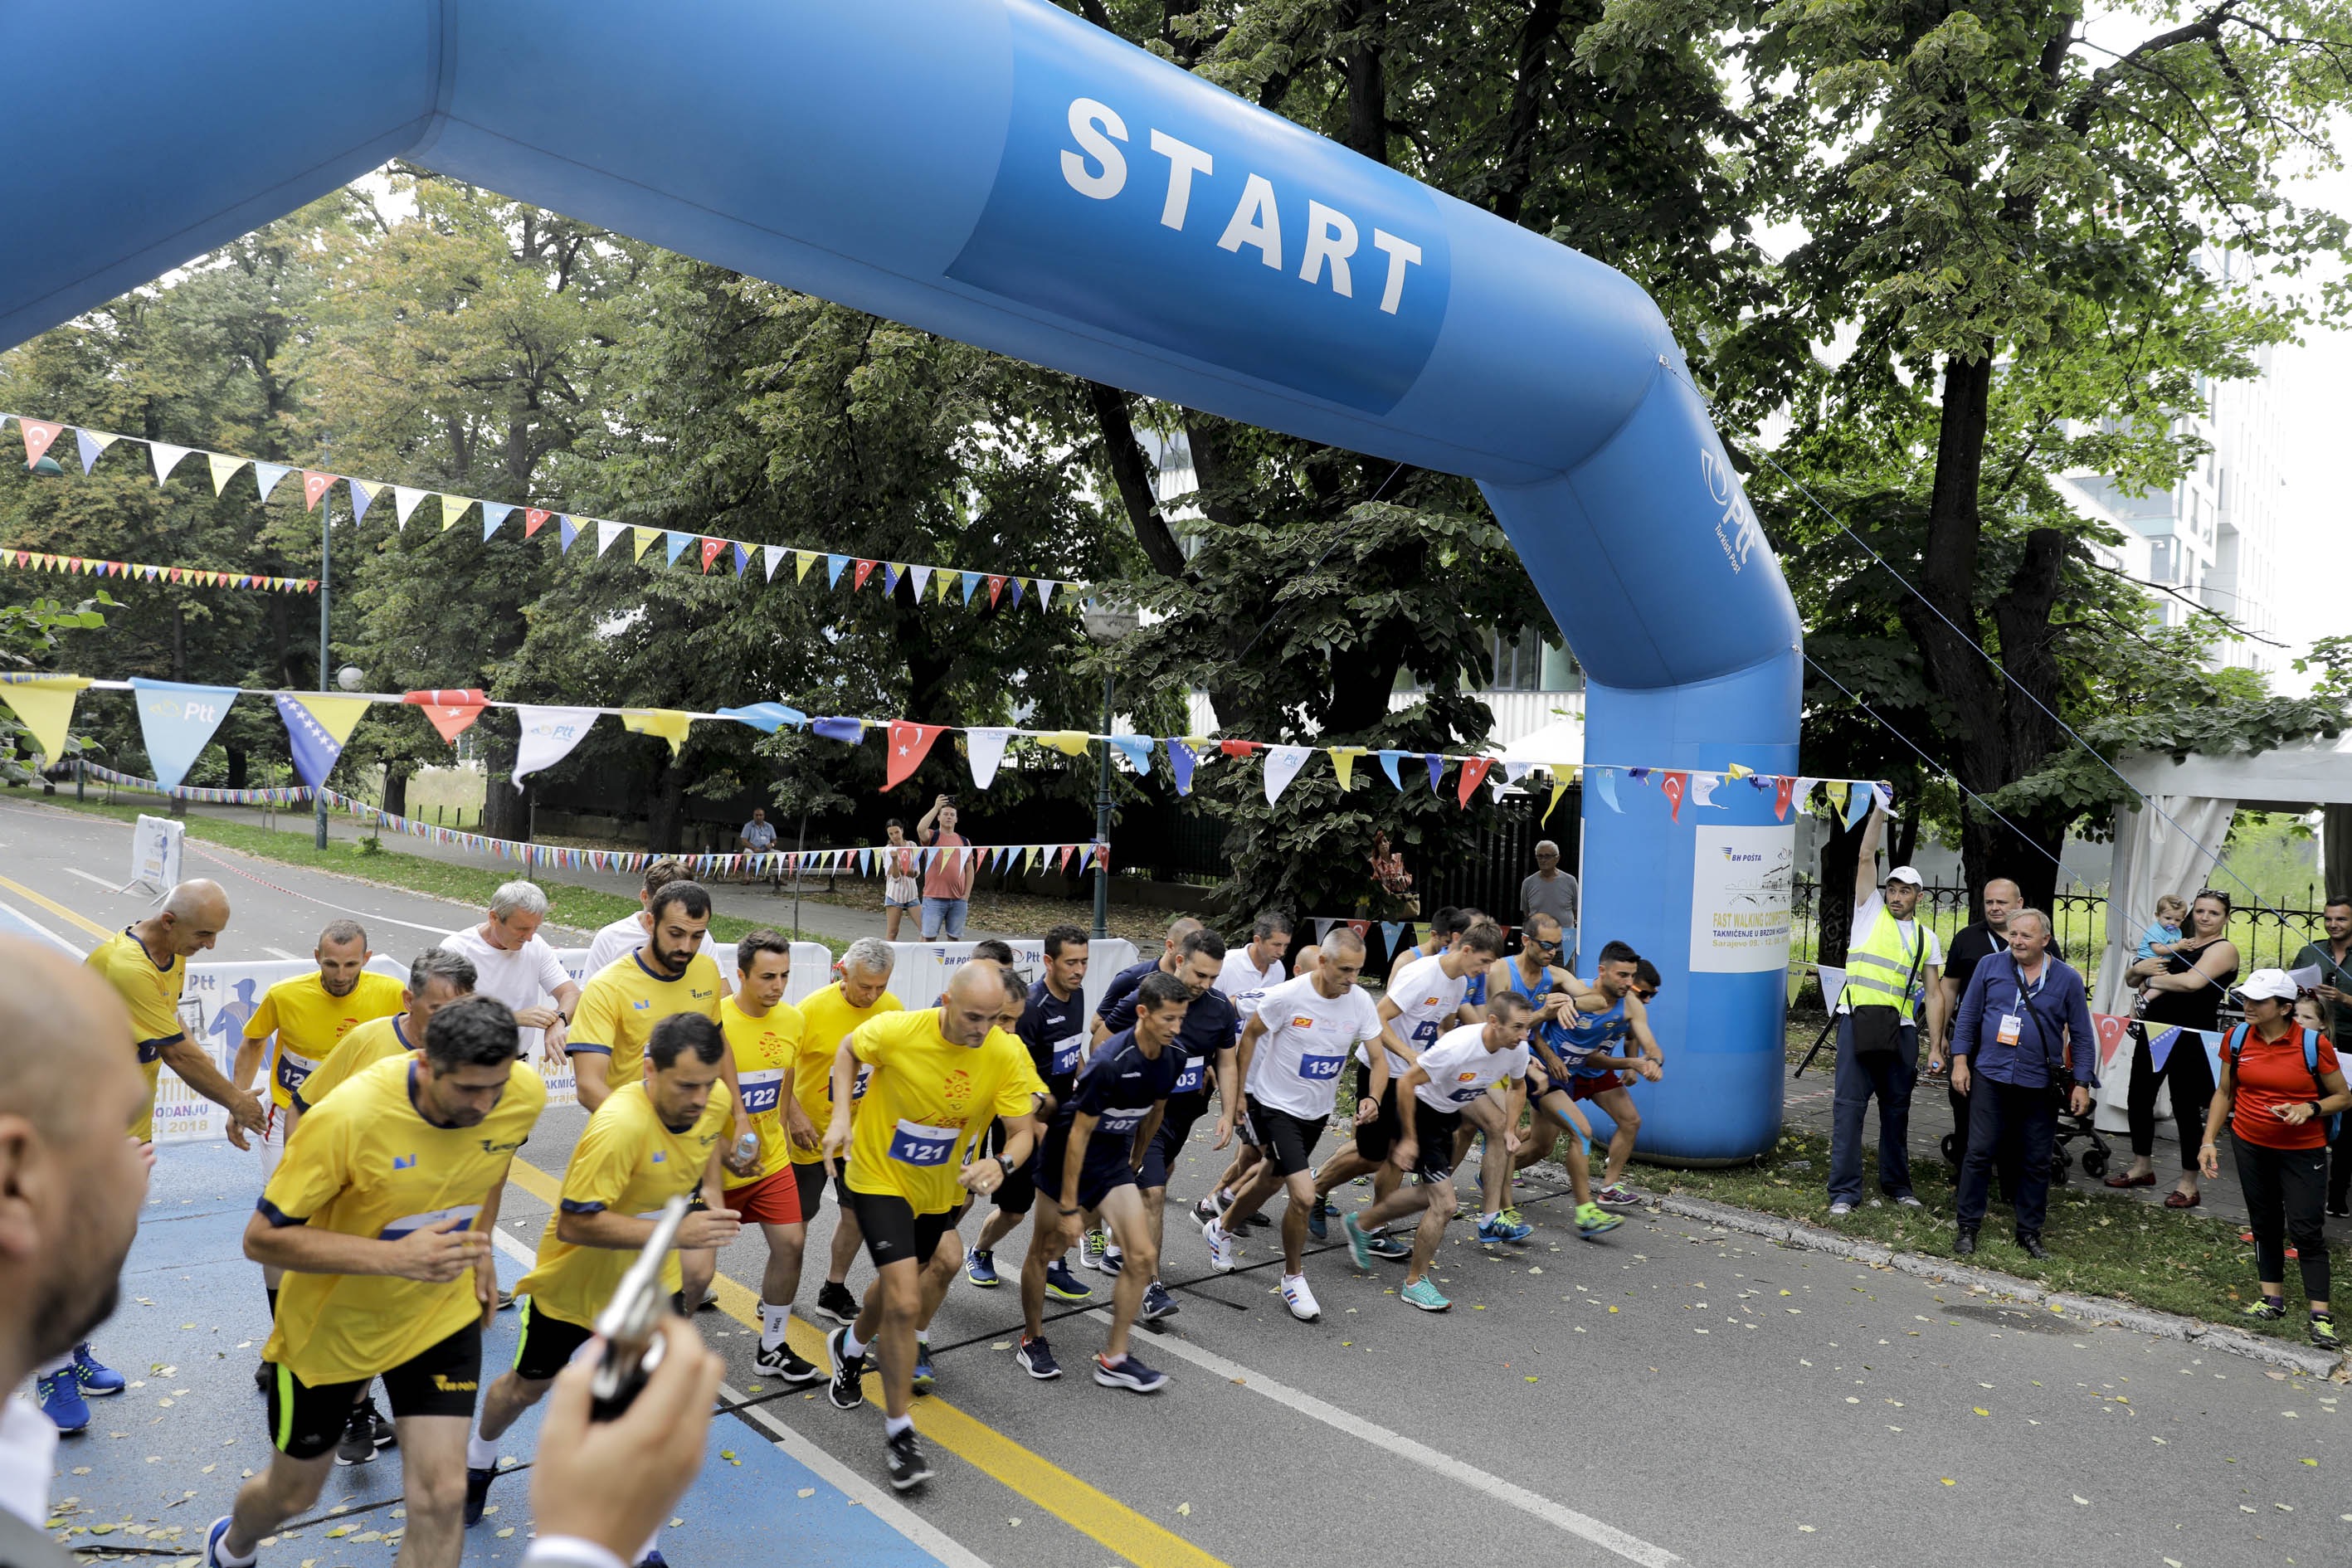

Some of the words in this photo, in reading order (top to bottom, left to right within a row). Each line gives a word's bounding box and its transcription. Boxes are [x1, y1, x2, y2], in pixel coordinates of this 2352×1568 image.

[1060, 98, 1422, 315] START
[1722, 493, 1755, 565] Ptt
[1714, 522, 1731, 556] Turkish
[1728, 553, 1741, 574] Post
[183, 702, 217, 723] Ptt
[551, 725, 576, 738] Ptt
[1742, 853, 1762, 862] POŠTA
[1713, 913, 1731, 928] FAST
[1734, 913, 1763, 928] WALKING
[1713, 928, 1753, 937] TAKMIČENJE
[1760, 928, 1775, 937] BRZOM
[1712, 938, 1747, 948] Sarajevo
[944, 957, 955, 965] BH
[1026, 951, 1040, 962] Ptt
[187, 974, 216, 991] Ptt
[1420, 1025, 1434, 1036] 13
[1309, 1061, 1340, 1074] 134
[285, 1068, 305, 1088] 12
[1176, 1072, 1196, 1087] 03
[852, 1080, 868, 1094] 23
[742, 1088, 776, 1108] 122
[154, 1103, 208, 1118] ODANJU
[168, 1119, 208, 1133] 2018
[1104, 1119, 1139, 1130] 107
[903, 1142, 946, 1160] 121
